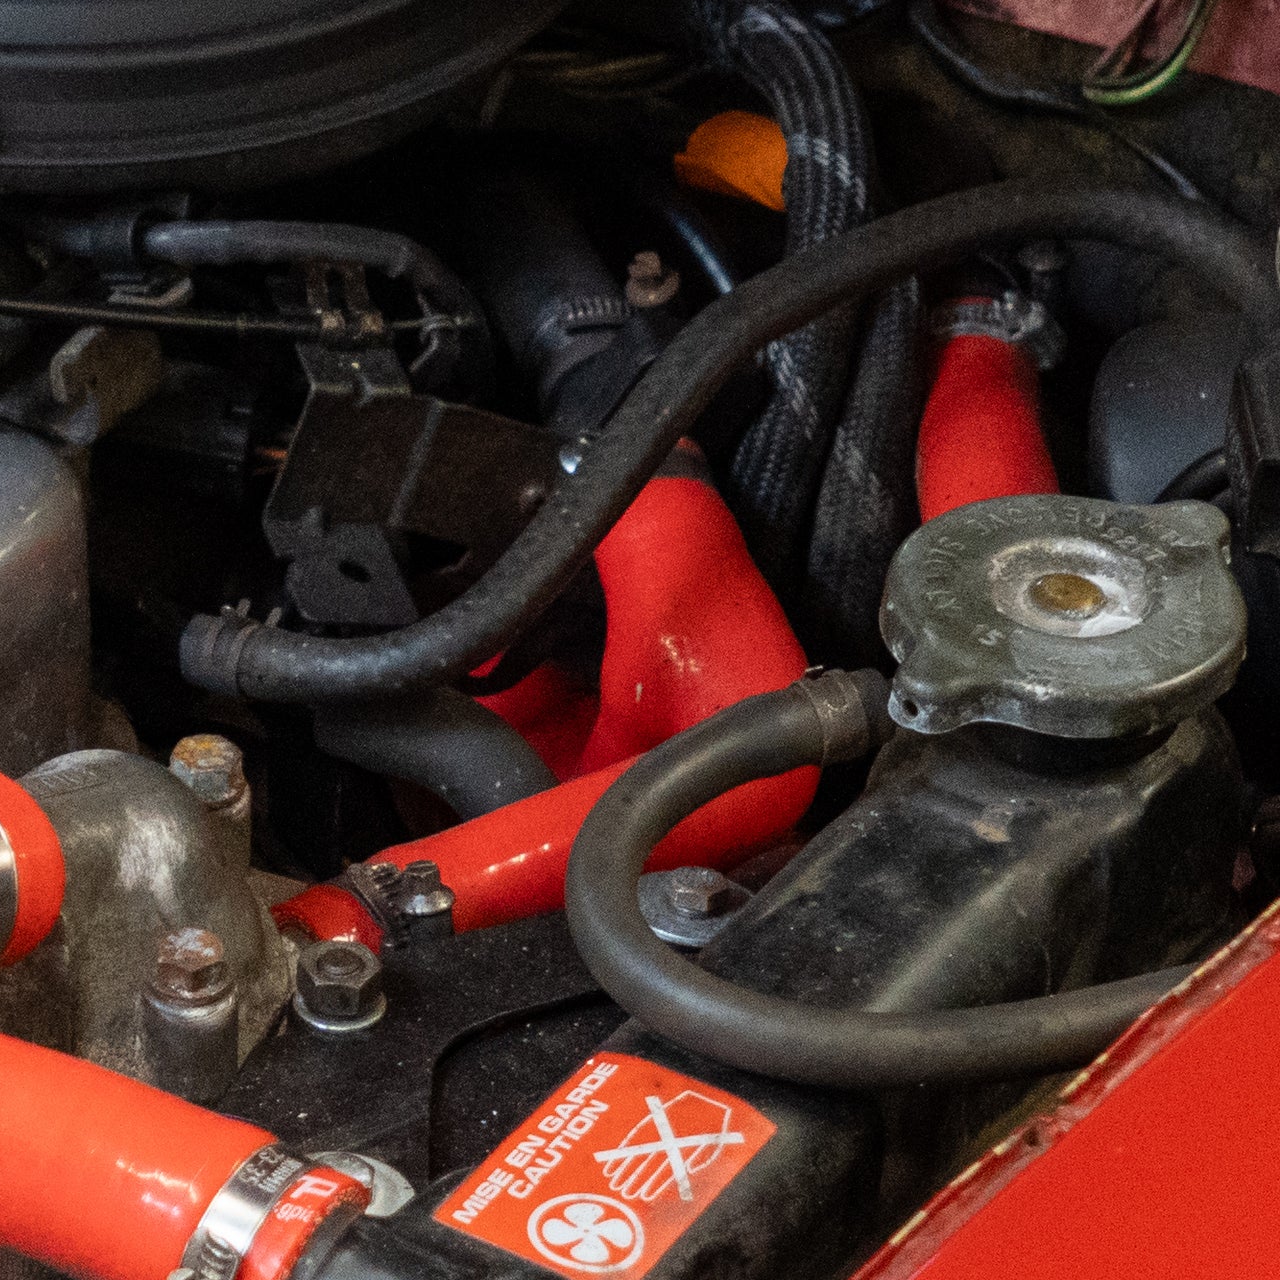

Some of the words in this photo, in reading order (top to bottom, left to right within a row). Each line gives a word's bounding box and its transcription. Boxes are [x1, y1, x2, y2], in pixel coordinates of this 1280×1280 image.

[451, 1167, 516, 1225] MISE
[504, 1133, 547, 1169] EN
[537, 1061, 620, 1134] GARDE
[506, 1099, 611, 1200] CAUTION
